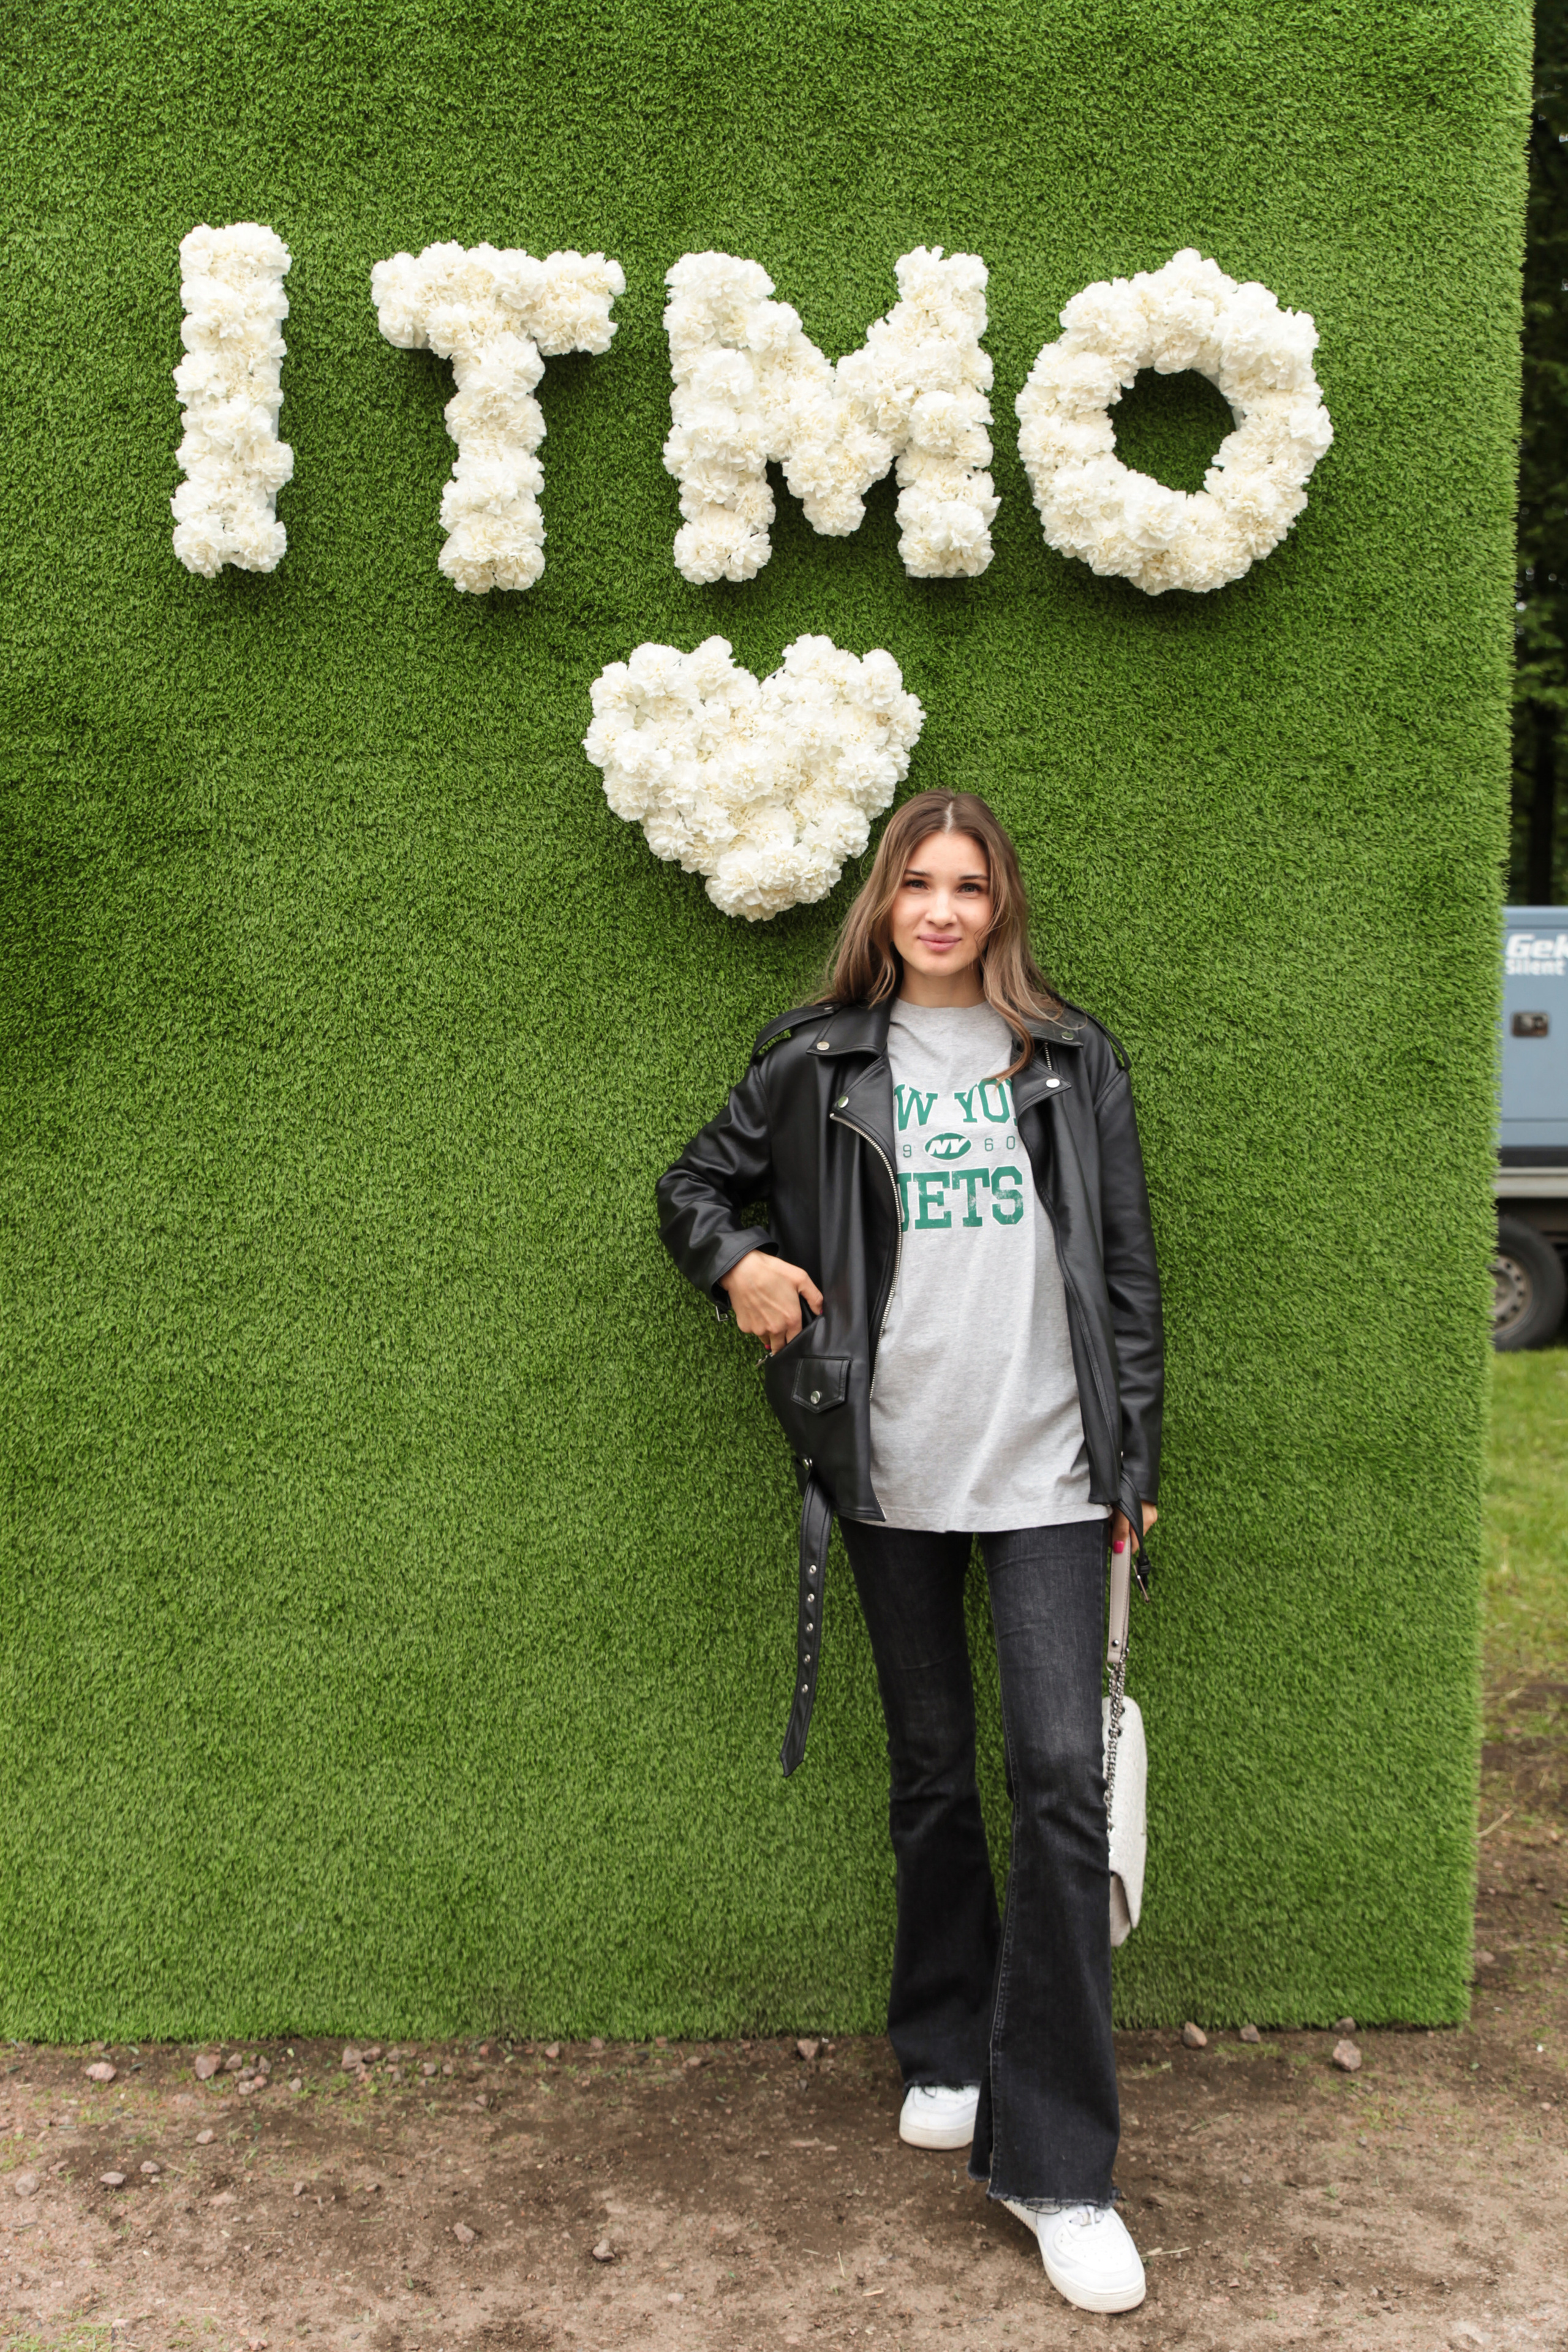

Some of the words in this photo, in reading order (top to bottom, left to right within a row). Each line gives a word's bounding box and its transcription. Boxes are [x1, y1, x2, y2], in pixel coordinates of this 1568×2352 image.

[172, 222, 1334, 595] ITMO
[954, 1077, 1017, 1127] YO
[927, 1138, 969, 1155] NY
